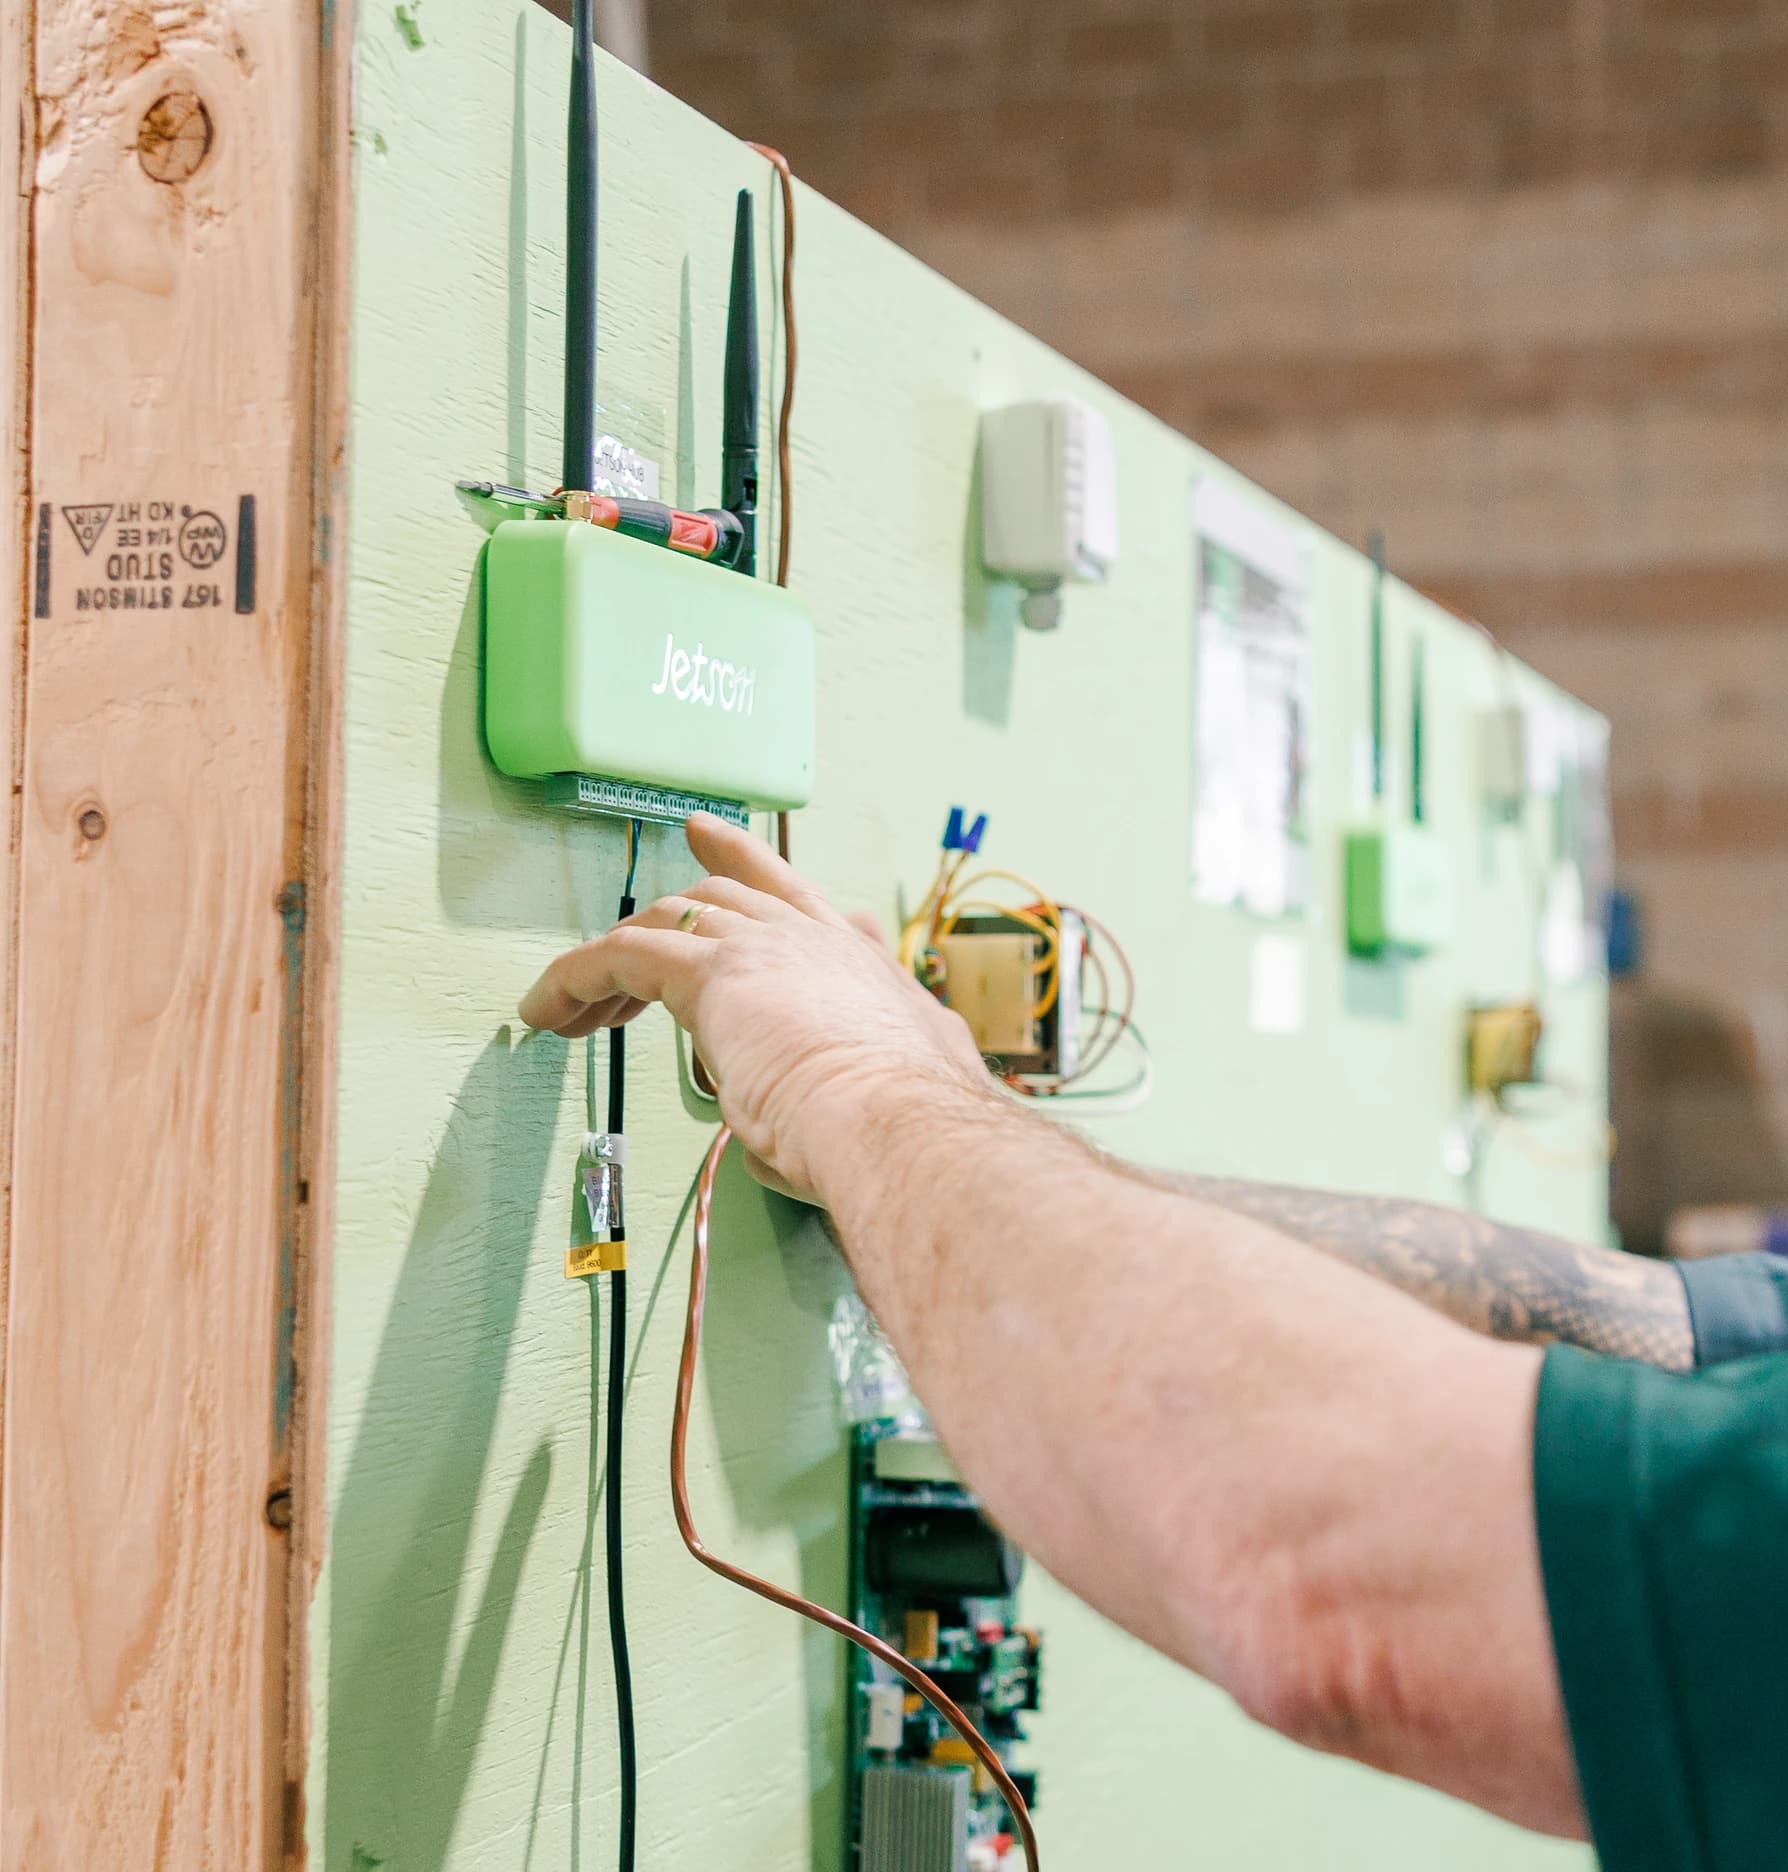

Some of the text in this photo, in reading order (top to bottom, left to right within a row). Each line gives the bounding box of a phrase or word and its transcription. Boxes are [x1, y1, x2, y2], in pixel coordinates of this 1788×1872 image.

[75, 511, 104, 526] FIR
[116, 501, 175, 523] KD HT
[117, 528, 174, 548] 1/4 EE
[106, 553, 174, 581] STUD
[76, 584, 222, 610] 167 STIMSON
[652, 632, 756, 715] Jetson
